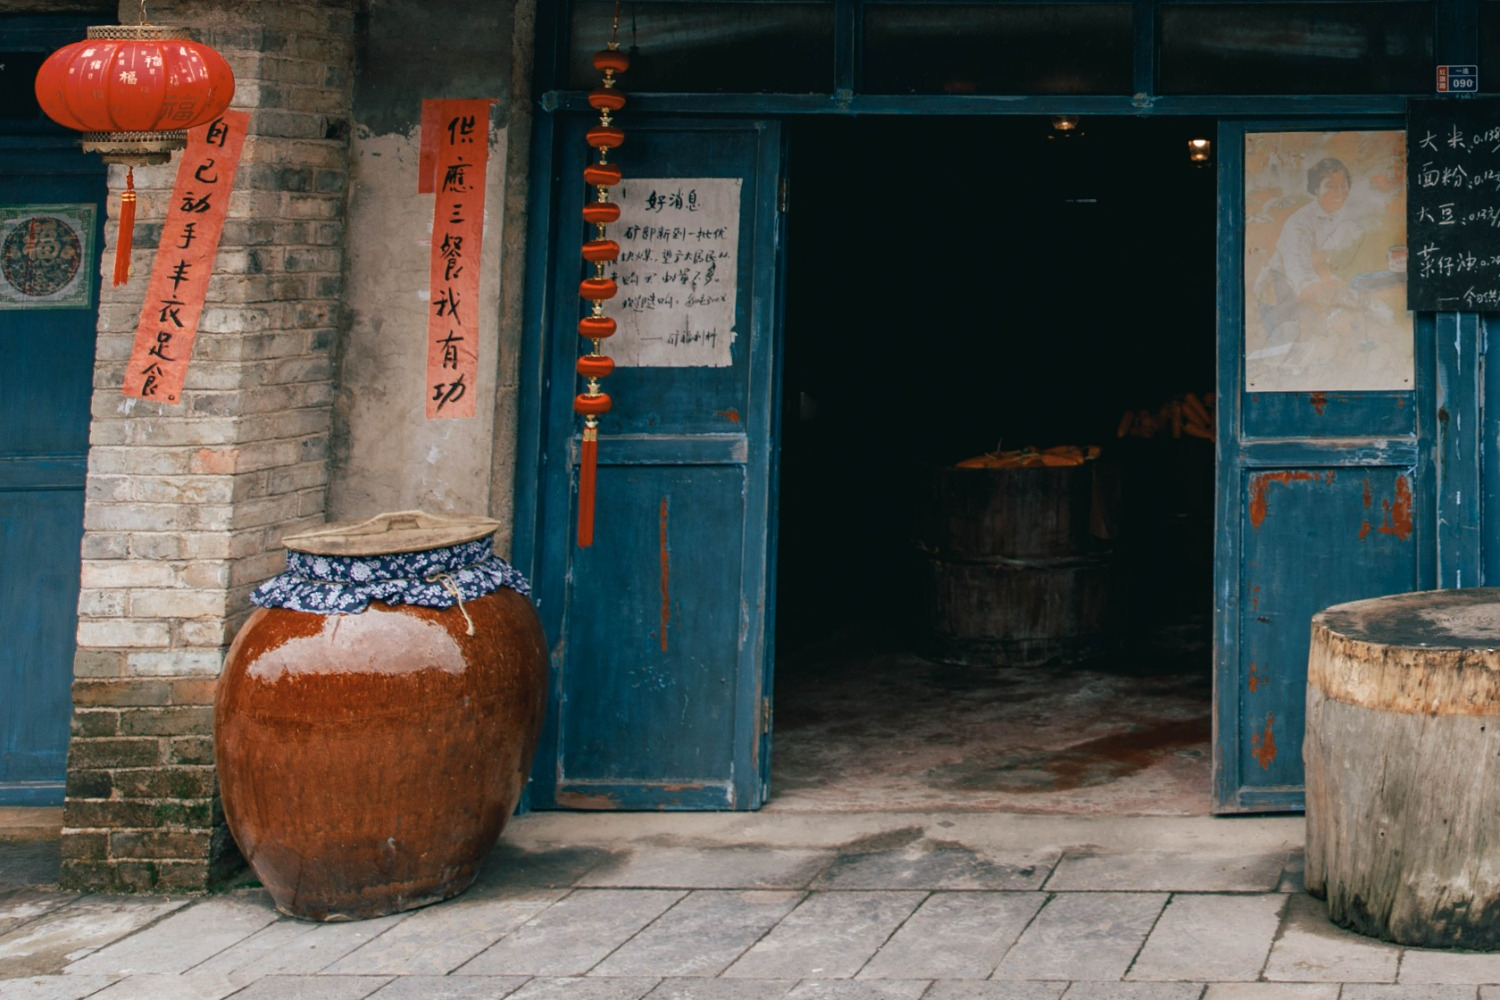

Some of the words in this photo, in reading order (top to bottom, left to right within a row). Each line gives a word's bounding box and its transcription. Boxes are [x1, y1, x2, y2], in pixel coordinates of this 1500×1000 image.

[1453, 79, 1472, 88] 090
[645, 188, 701, 213] 好消息
